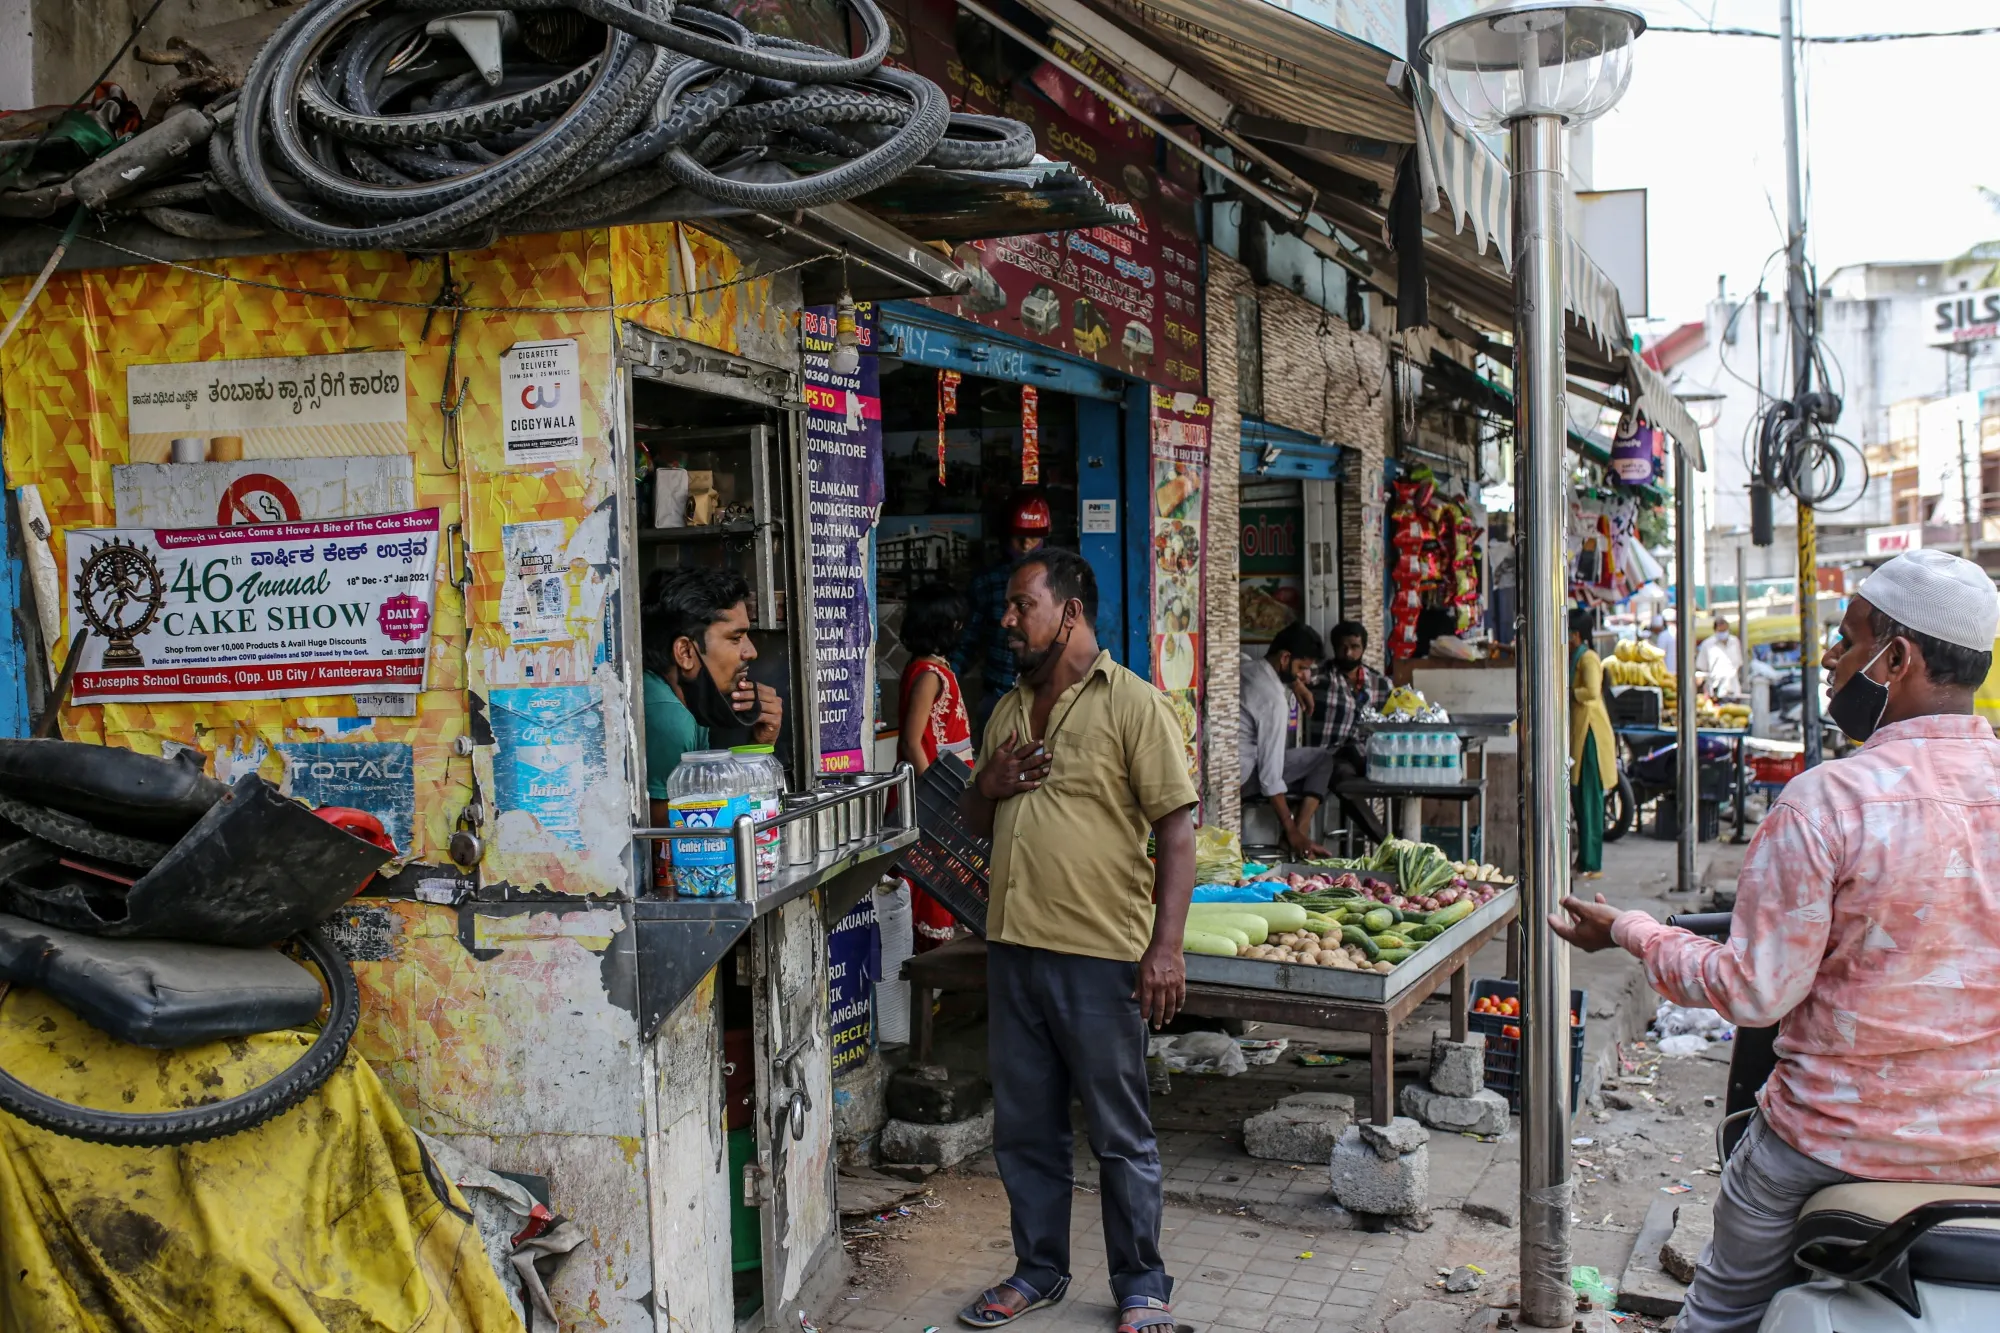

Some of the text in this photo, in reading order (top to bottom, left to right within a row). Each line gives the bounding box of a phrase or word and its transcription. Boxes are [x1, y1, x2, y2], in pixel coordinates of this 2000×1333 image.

[1091, 226, 1132, 255] DISHES
[1113, 224, 1148, 245] LABLE
[1064, 258, 1079, 277] &
[1082, 265, 1154, 308] TRAVELS
[1082, 282, 1152, 322] TRAVELS)
[820, 316, 828, 336] &
[829, 318, 871, 346] TELS
[890, 324, 928, 360] ONLY
[518, 349, 559, 359] CIGARETTE
[804, 354, 829, 369] 9704
[521, 361, 557, 370] DELIVERY
[208, 376, 274, 403] ತಂಬಾಕು
[349, 369, 399, 396] ಕಾರಣ
[804, 369, 861, 390] 0360 00184
[820, 391, 835, 408] TO
[511, 415, 576, 432] CIGGYWALA
[809, 480, 859, 498] ELANKANI
[810, 502, 876, 519] ONDICHERRY
[218, 529, 246, 540] Cake,
[248, 527, 275, 537] Come
[277, 525, 283, 536] &
[285, 524, 311, 535] Have
[313, 523, 321, 534] A
[323, 521, 341, 533] Bite
[344, 520, 354, 531] of
[356, 519, 373, 531] The
[375, 518, 401, 530] Cake
[403, 516, 433, 528] Show
[810, 522, 861, 539] URATHKAL
[1242, 514, 1296, 557] oint
[323, 542, 368, 562] ಕೇಕ್
[376, 537, 428, 565] ಉತ್ಸವ
[811, 543, 846, 558] IJAPUR
[522, 555, 552, 566] YEARS OF
[362, 575, 377, 585] Dec
[394, 573, 408, 583] Jan
[410, 573, 429, 582] 2021
[812, 564, 863, 579] IJAYAWAD
[236, 568, 331, 604] Annual
[813, 586, 855, 599] HARWAD
[164, 602, 371, 637] CAKE SHOW
[387, 608, 420, 620] DAILY
[814, 606, 847, 620] ARWAR
[385, 623, 401, 631] 11am
[814, 627, 844, 641] OLLAM
[165, 646, 183, 654] Shop
[185, 645, 202, 653] from
[221, 643, 245, 651] 10,000
[246, 641, 279, 650] Products
[280, 640, 286, 648] &
[288, 639, 306, 647] Avail
[307, 638, 328, 648] Huge
[330, 637, 367, 646] Discounts
[258, 652, 287, 660] guidelines
[314, 649, 333, 657] issued
[353, 648, 369, 656] Govt.
[815, 647, 866, 662] ANTRALAY
[83, 674, 139, 690] St.Josephs
[143, 672, 180, 687] School
[183, 671, 231, 685] Grounds,
[235, 670, 264, 685] (Opp.
[267, 669, 283, 681] UB
[286, 668, 308, 682] City
[318, 666, 382, 679] Kanteerava
[816, 668, 849, 682] AYNAD
[384, 695, 405, 705] Cities
[817, 689, 851, 703] ATKAL
[820, 709, 848, 723] LICUT
[291, 761, 404, 779] TOTAL
[825, 755, 850, 772] TOUR
[677, 839, 701, 853] Center
[703, 838, 727, 853] fresh
[333, 926, 369, 942] CAUSES
[371, 926, 394, 942] CAN
[831, 998, 869, 1026] ANGABA
[832, 1022, 869, 1048] PECIA
[832, 1044, 865, 1069] SHAN
